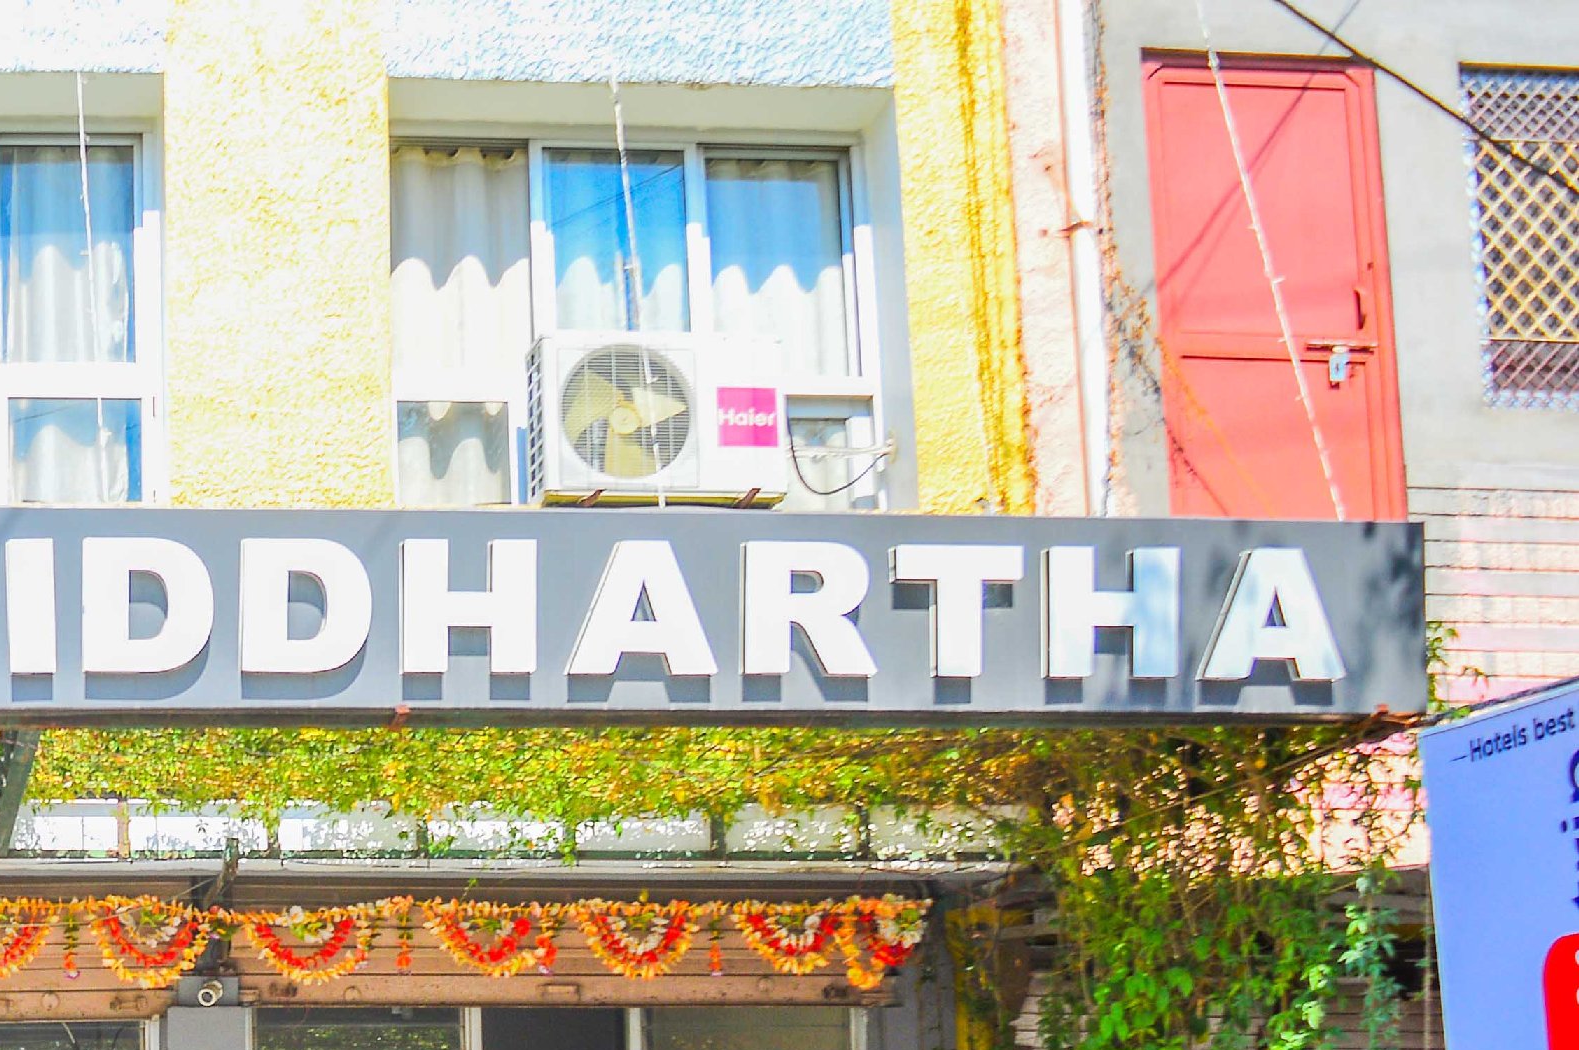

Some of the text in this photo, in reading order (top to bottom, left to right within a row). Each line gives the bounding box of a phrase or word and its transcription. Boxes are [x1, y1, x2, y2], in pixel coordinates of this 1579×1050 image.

[718, 406, 776, 427] Haier
[1469, 707, 1576, 762] Hotels best
